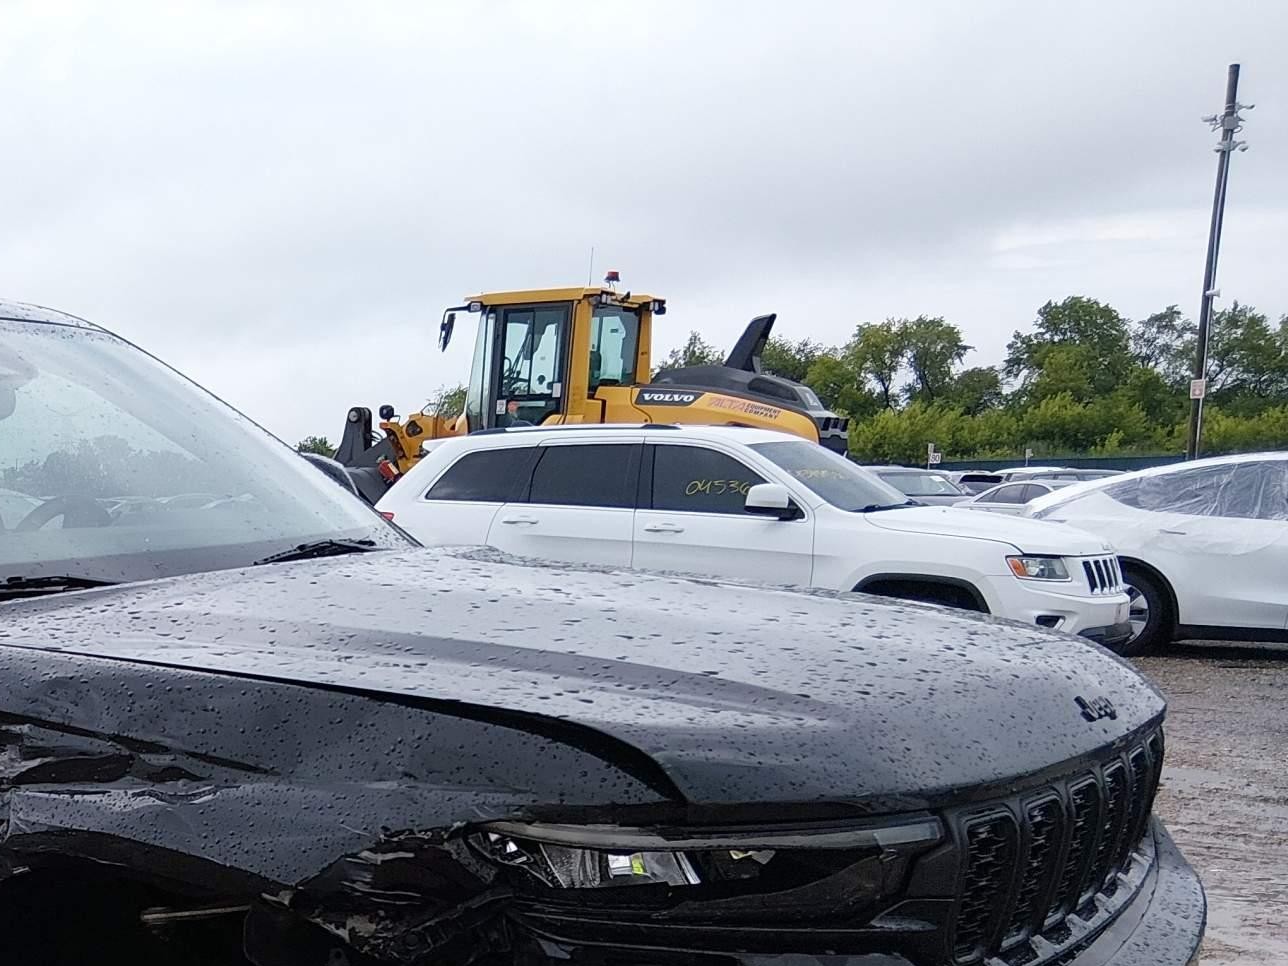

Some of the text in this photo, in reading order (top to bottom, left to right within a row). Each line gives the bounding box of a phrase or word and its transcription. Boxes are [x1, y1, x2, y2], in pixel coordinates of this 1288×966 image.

[642, 392, 695, 402] VOLVO
[743, 407, 778, 419] COMPANY
[745, 402, 781, 416] EQUIPMENT
